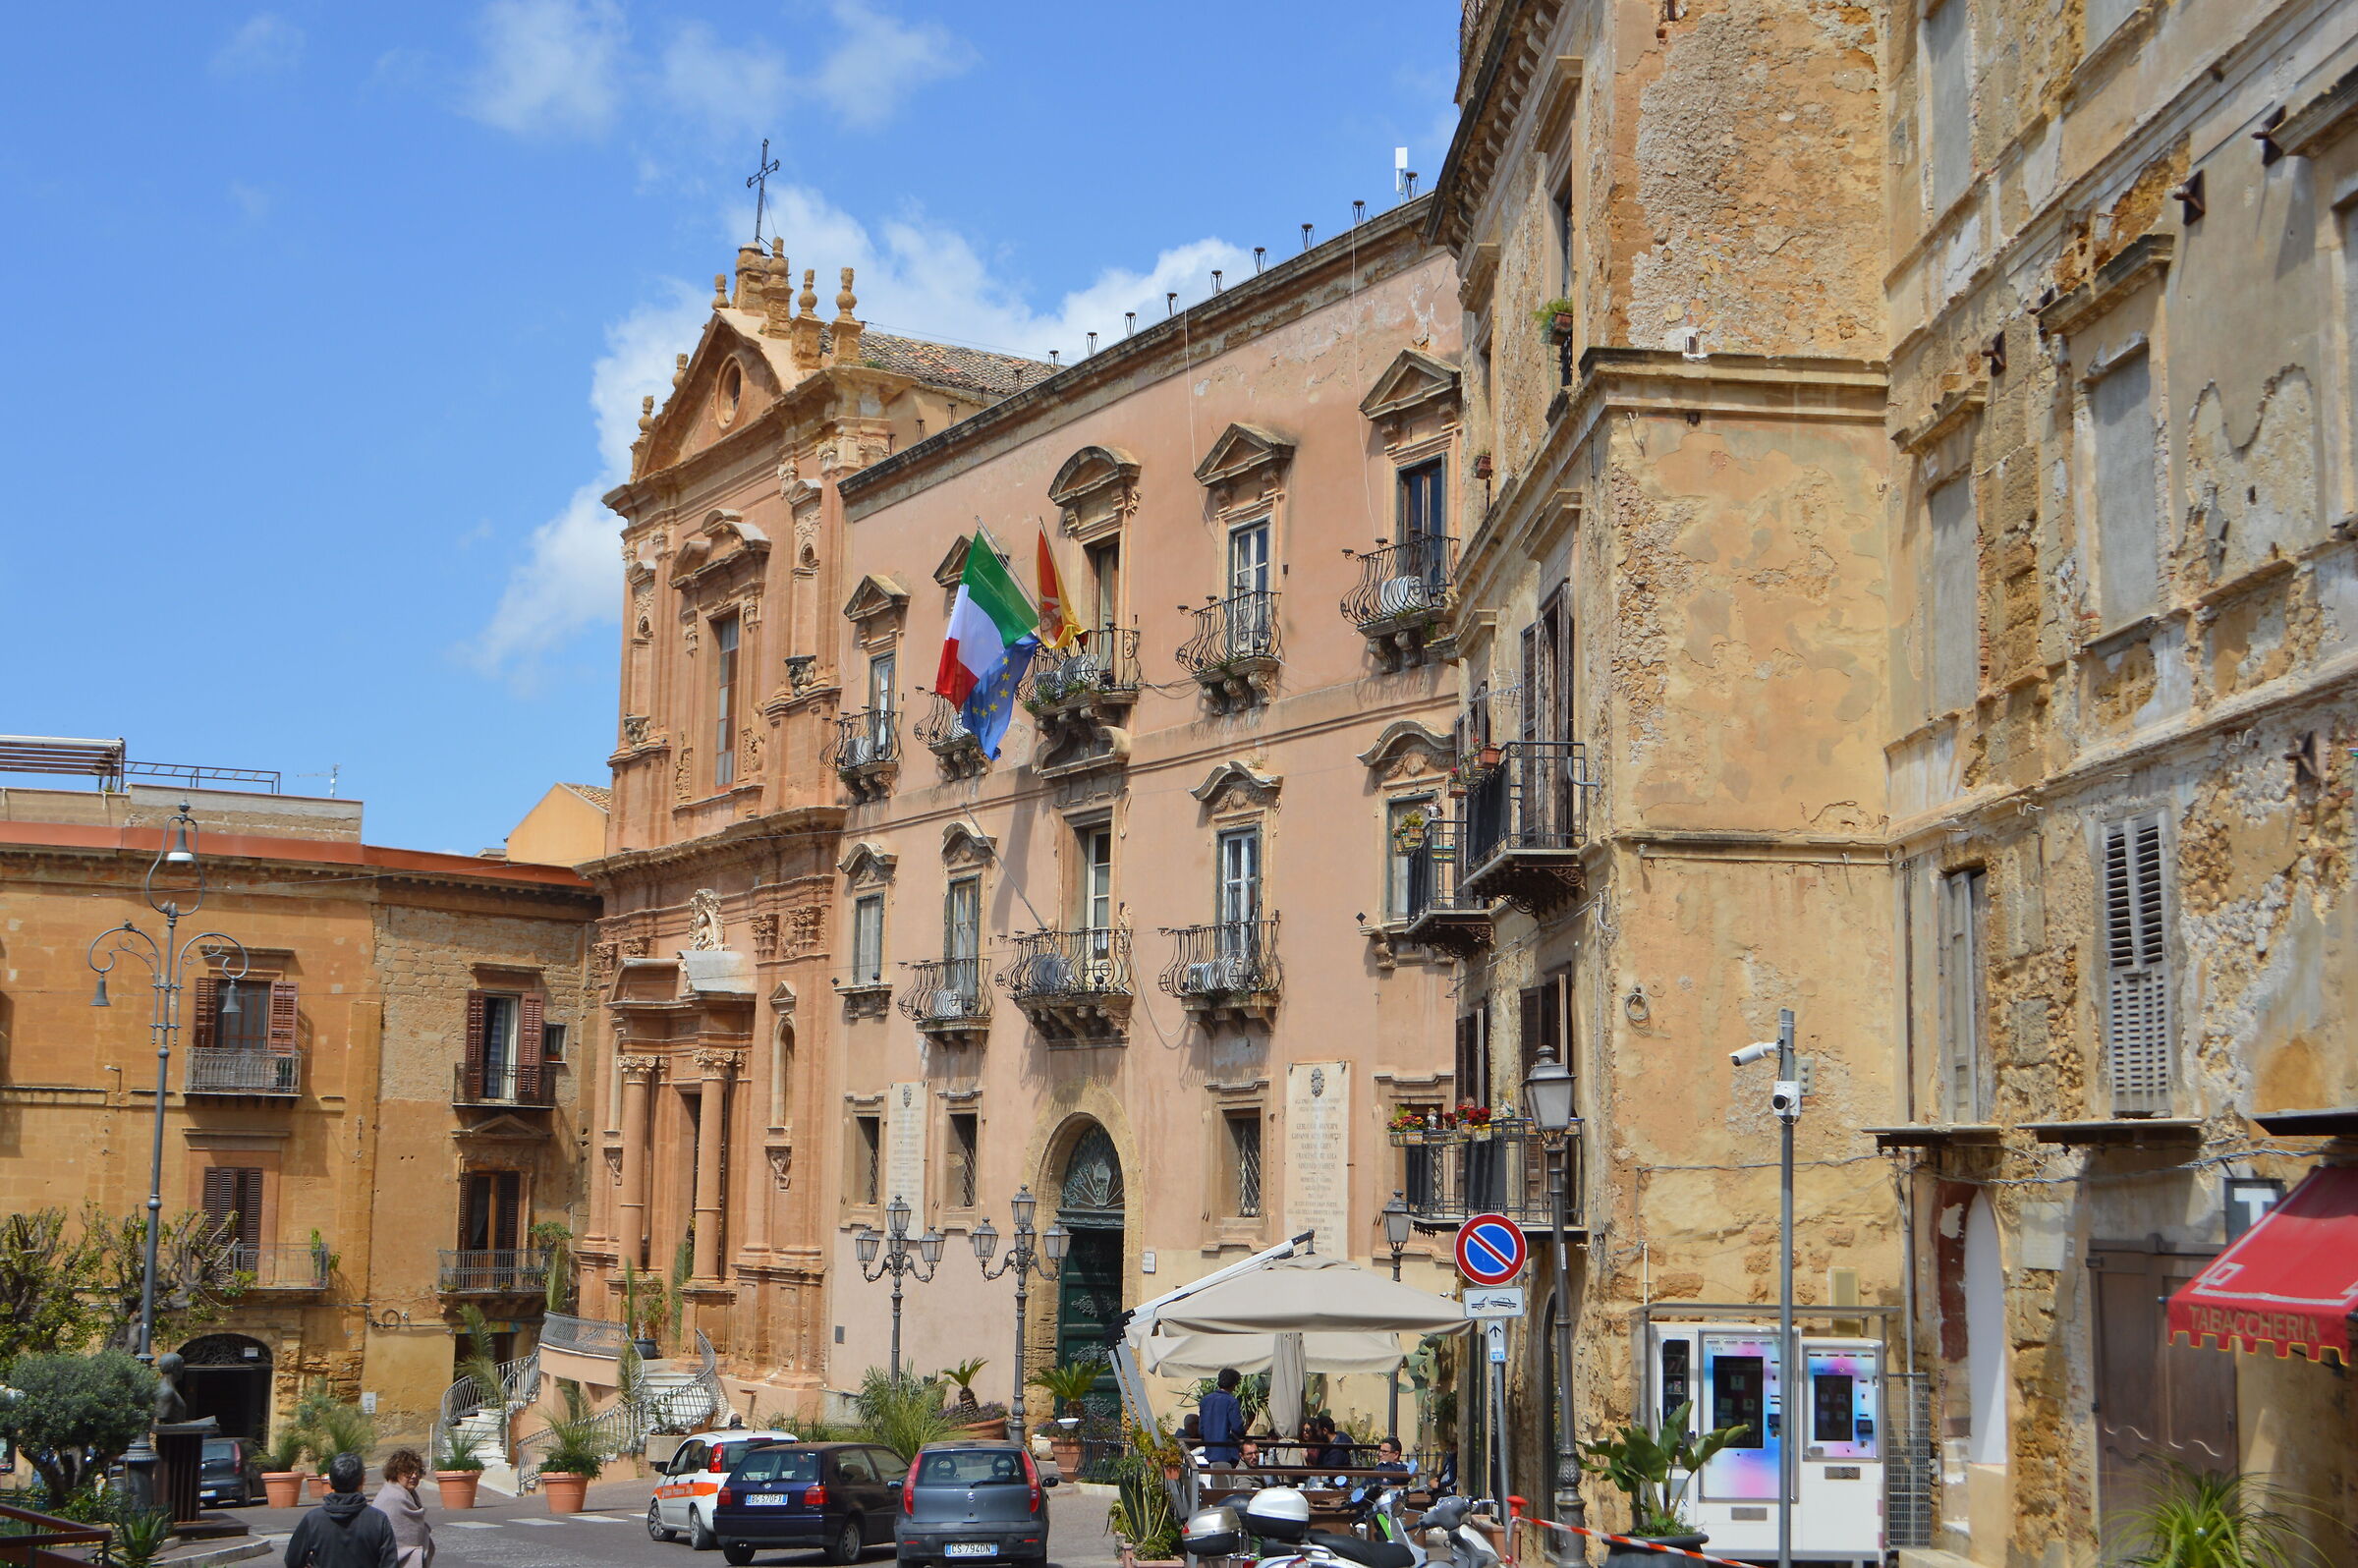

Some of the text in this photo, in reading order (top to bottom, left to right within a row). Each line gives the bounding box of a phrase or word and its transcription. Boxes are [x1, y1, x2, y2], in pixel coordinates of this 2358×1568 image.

[2234, 1187, 2278, 1227] T
[2188, 1305, 2320, 1342] TABACCHERIA
[952, 1543, 962, 1553] CS
